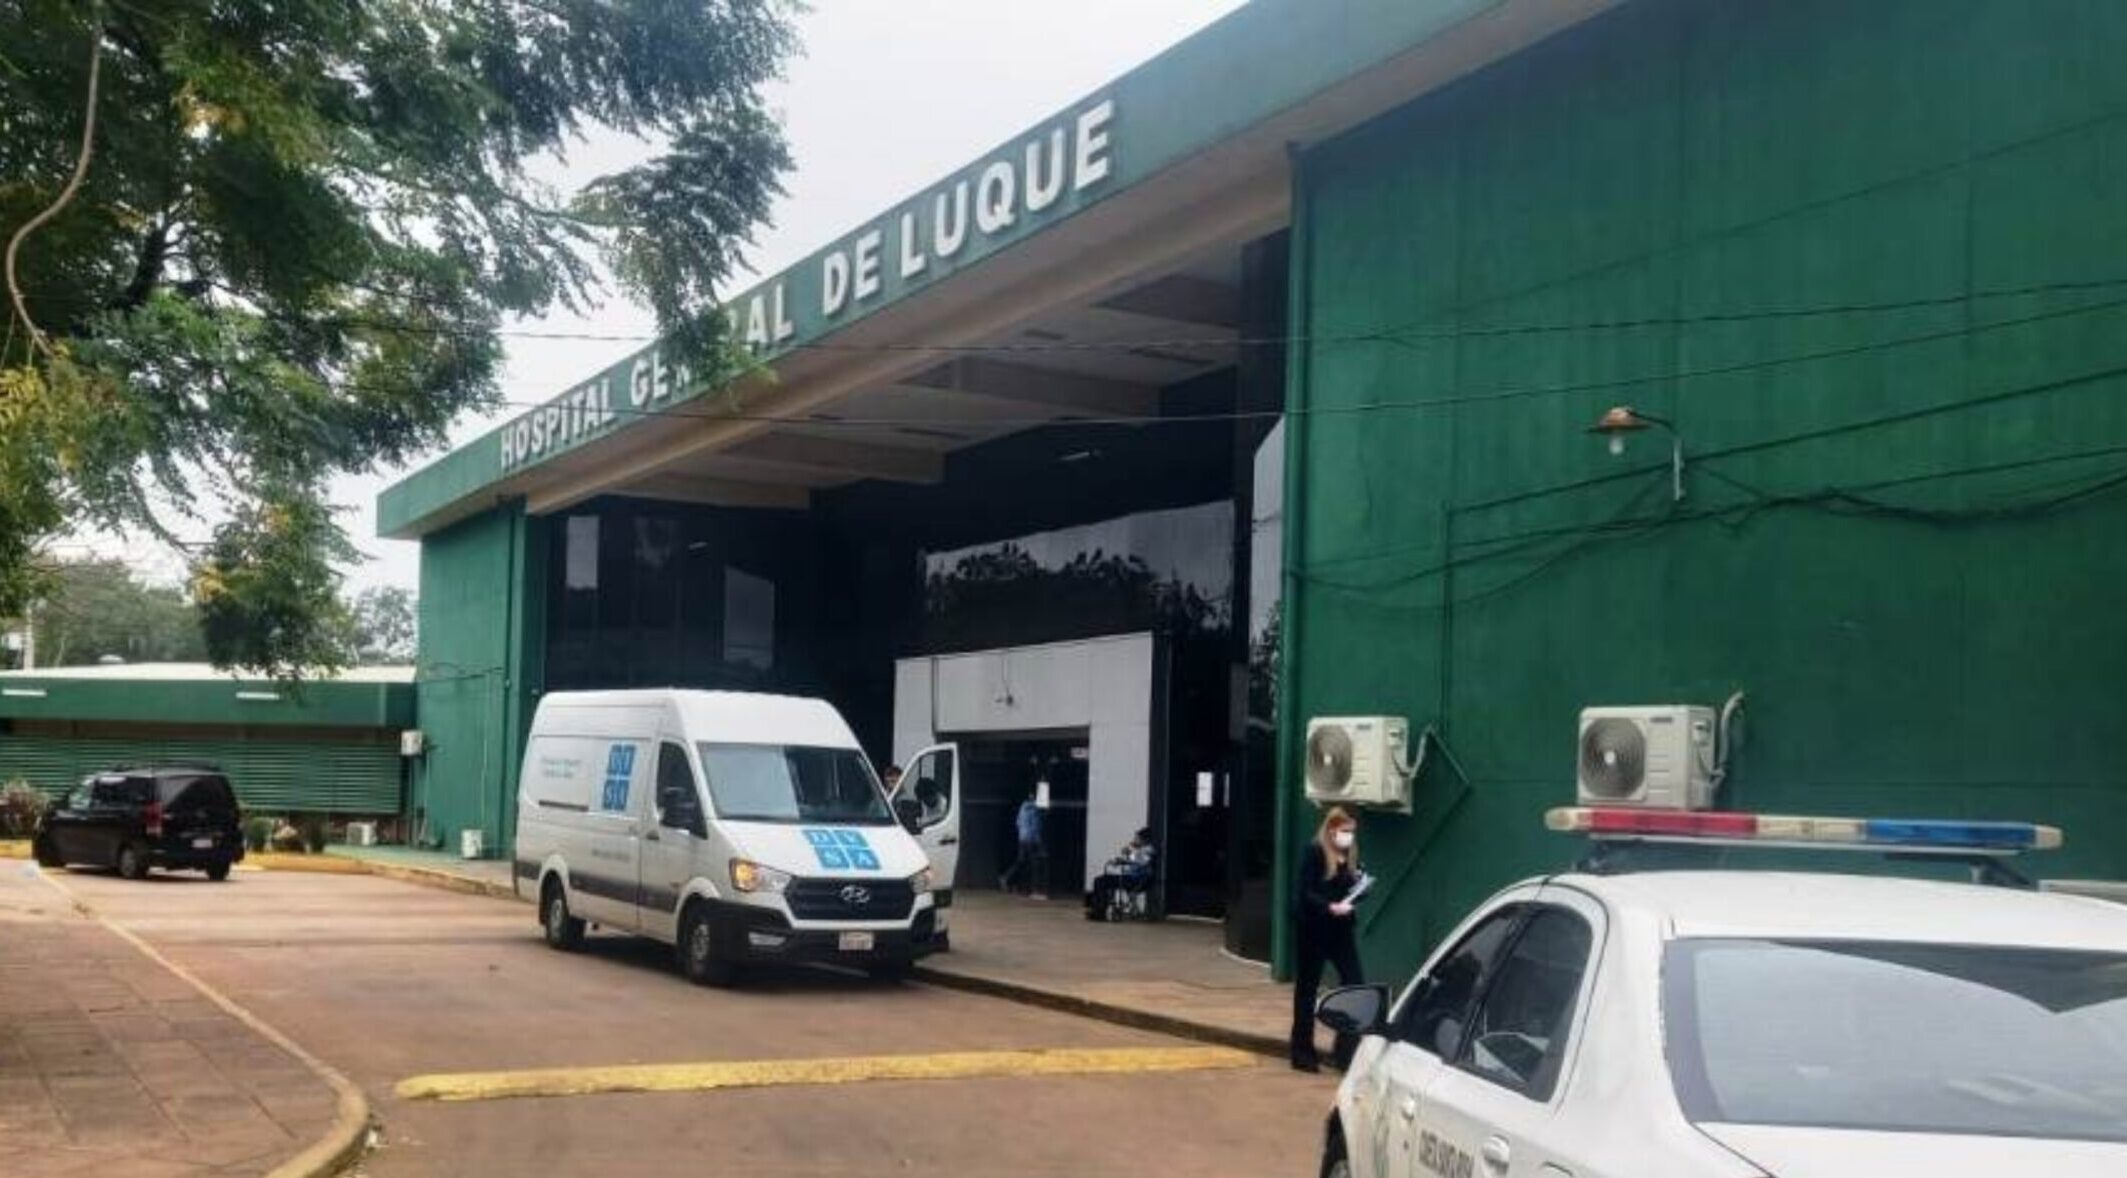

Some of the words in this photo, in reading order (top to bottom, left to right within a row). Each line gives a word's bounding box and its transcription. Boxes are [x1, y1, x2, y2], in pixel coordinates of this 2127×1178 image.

[501, 377, 615, 471] HOSPITAL
[631, 283, 793, 406] GENAL
[823, 230, 881, 316] DE
[902, 99, 1114, 279] LUQUE
